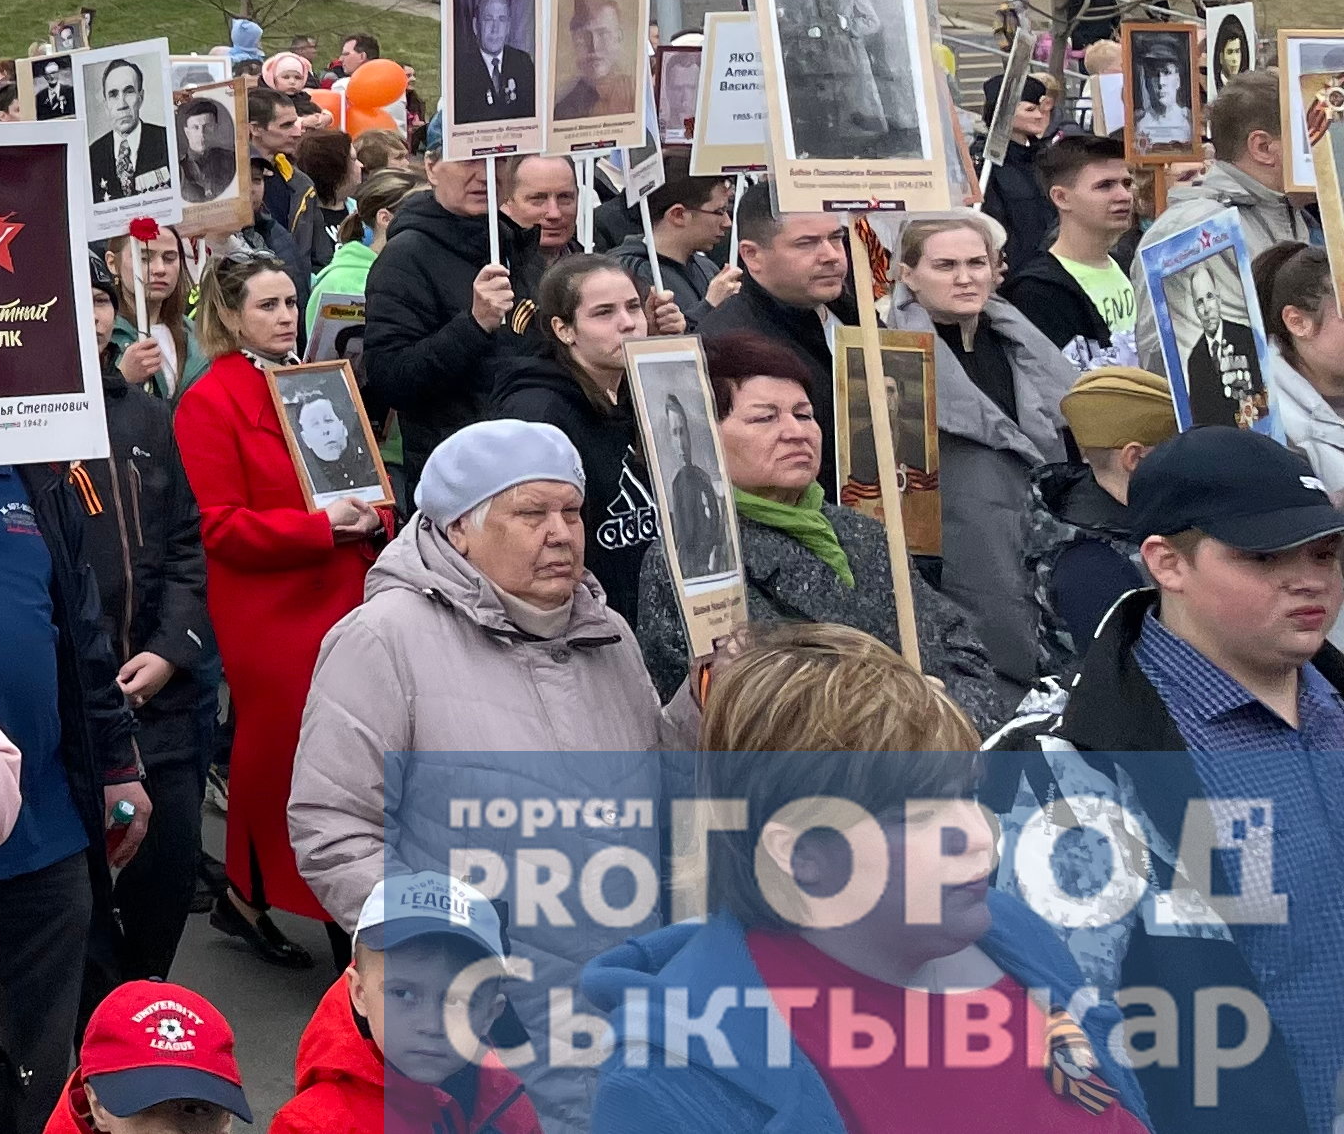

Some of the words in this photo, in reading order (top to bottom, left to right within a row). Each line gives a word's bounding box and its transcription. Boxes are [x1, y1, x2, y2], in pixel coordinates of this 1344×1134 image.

[16, 400, 90, 416] Степанович
[400, 891, 477, 921] LEAGUE
[131, 999, 205, 1025] UNIVERSITY
[149, 1038, 196, 1052] LEAGUE
